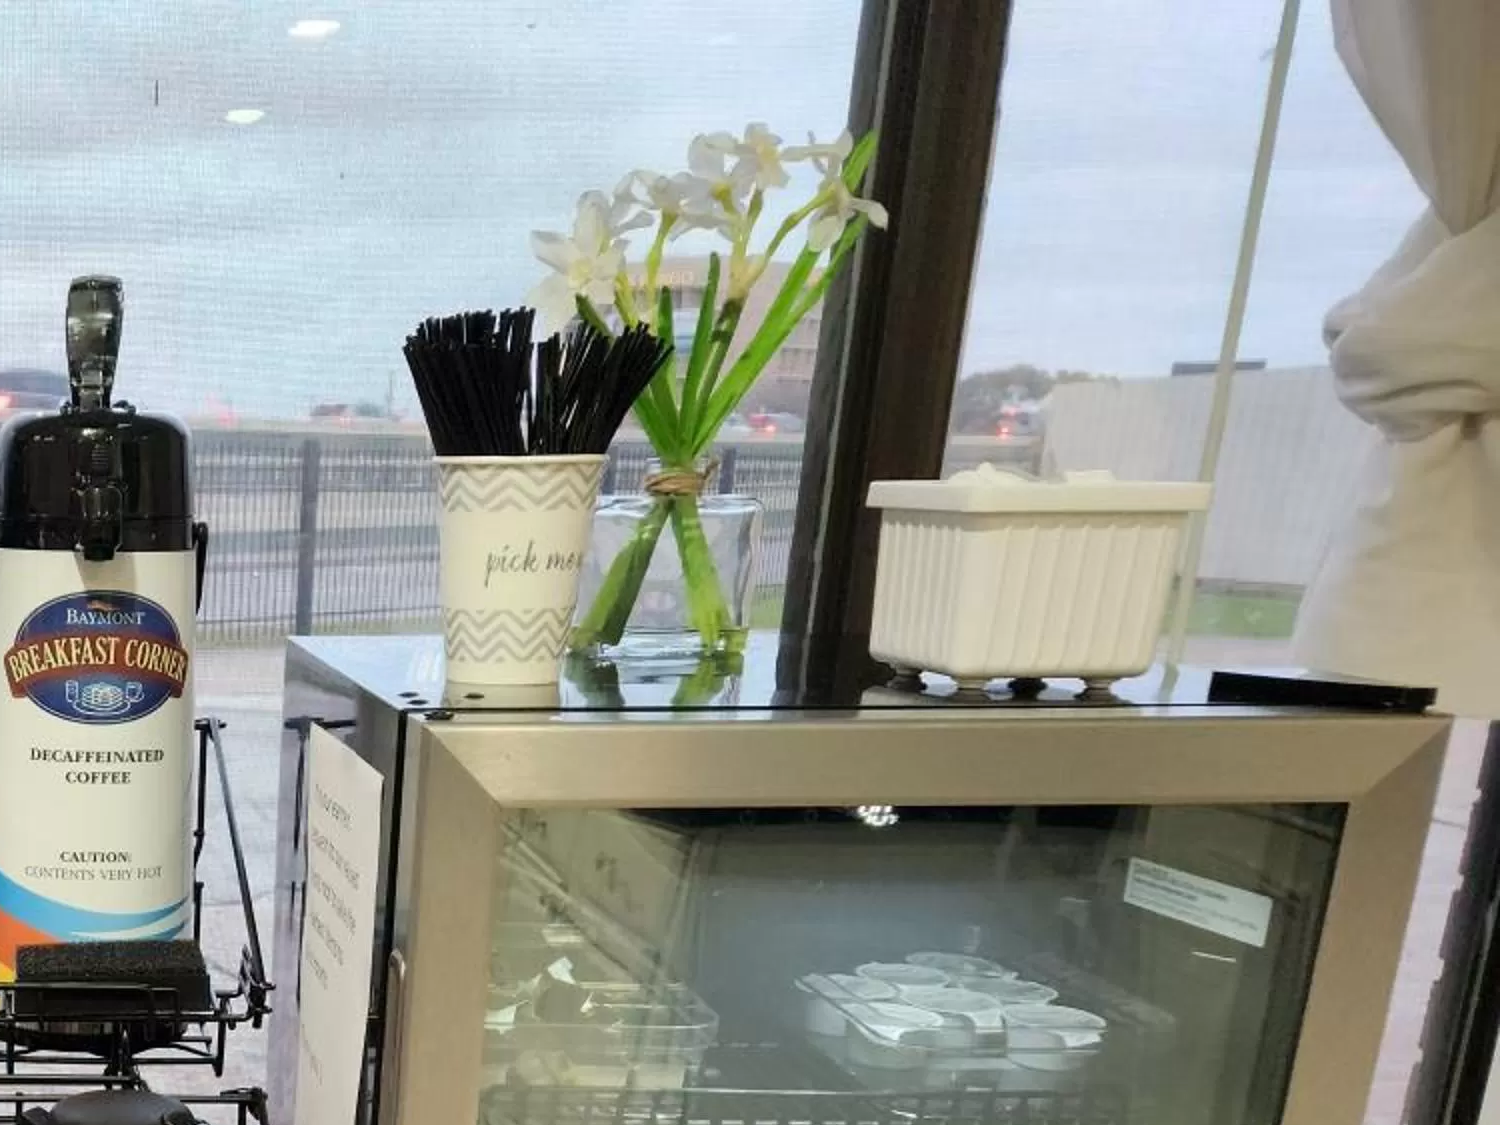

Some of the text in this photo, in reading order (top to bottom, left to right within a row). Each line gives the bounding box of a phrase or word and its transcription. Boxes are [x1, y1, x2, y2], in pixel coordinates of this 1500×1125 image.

[484, 540, 539, 588] pick
[8, 636, 187, 684] BREAKFAST CORNER
[29, 747, 165, 763] DECAFFEINATED
[65, 770, 132, 785] COFFEE
[24, 865, 164, 882] CONTENTS VERY HOT
